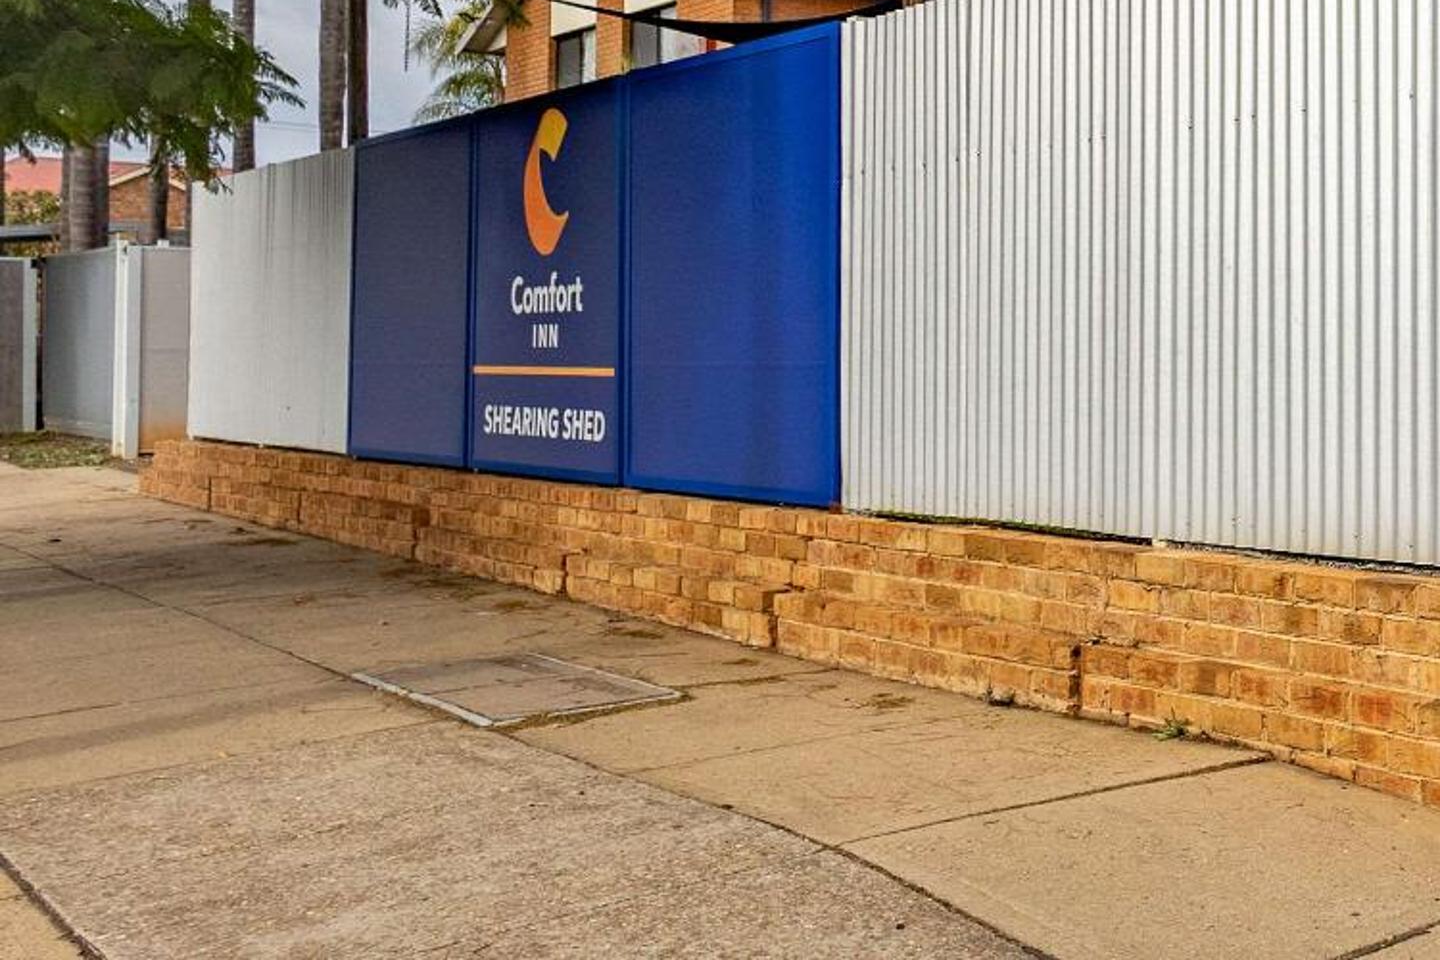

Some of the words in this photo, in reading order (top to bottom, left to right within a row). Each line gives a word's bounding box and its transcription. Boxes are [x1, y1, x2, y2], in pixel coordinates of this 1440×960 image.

[511, 271, 584, 315] Comfort
[532, 324, 559, 348] INN
[484, 404, 559, 438] SHEARING
[562, 409, 606, 442] SHED
